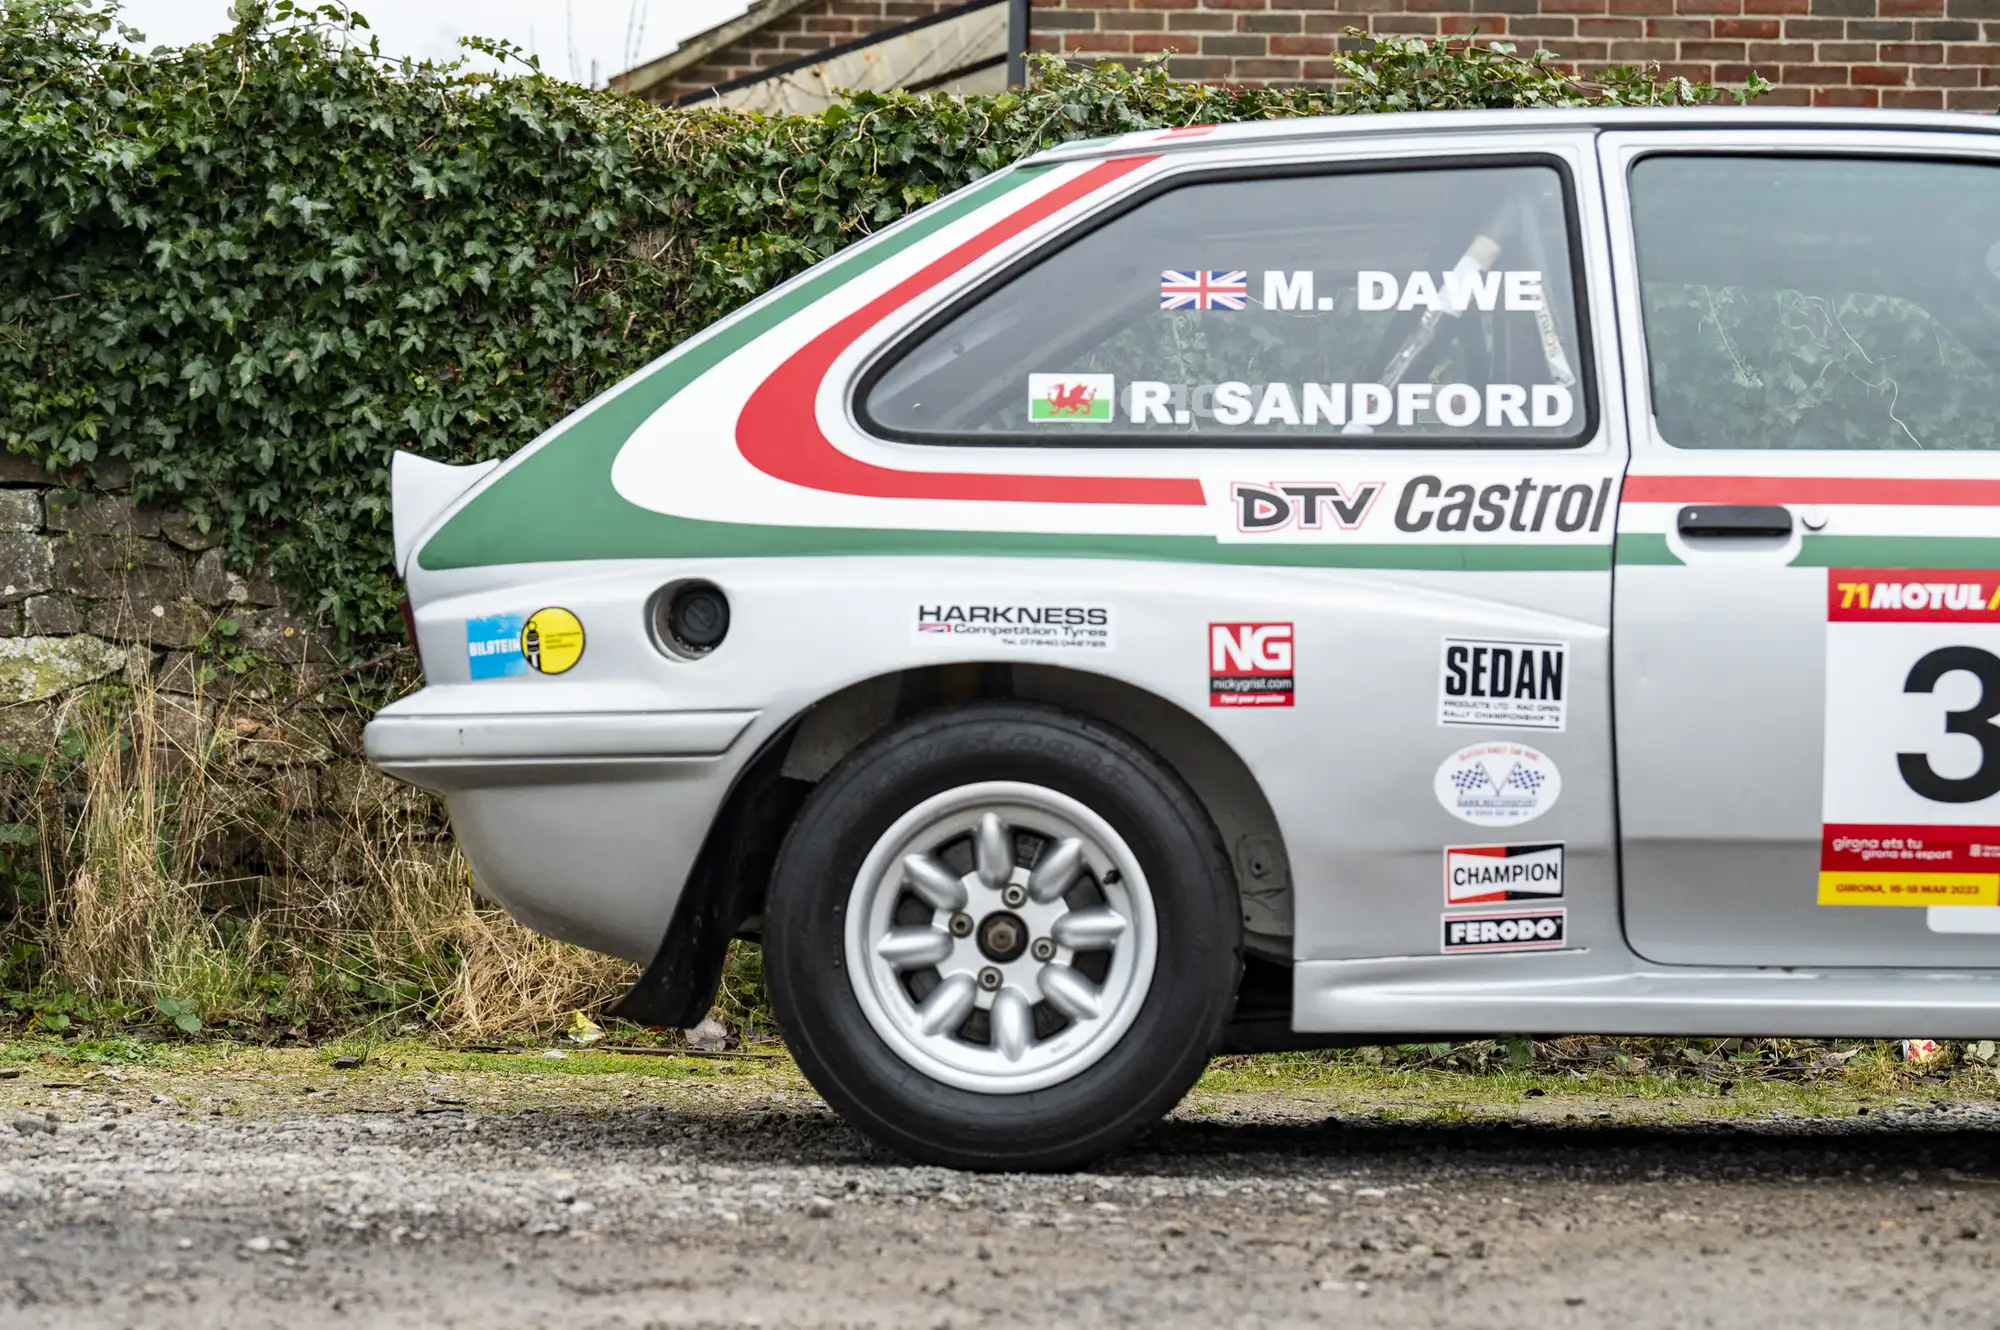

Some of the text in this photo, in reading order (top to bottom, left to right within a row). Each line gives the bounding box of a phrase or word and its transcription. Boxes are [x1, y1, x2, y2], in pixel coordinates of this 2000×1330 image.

[1263, 271, 1543, 312] M. DAWE
[1130, 380, 1574, 428] R. SANDFORD
[1237, 475, 1613, 533] DTV Castrol
[918, 605, 1108, 625] HARKNESS
[954, 623, 1108, 639] Competition Tyres
[469, 638, 521, 657] BILSTEIN
[1212, 625, 1292, 671] NG
[1446, 646, 1563, 700] SEDAN
[1212, 678, 1293, 691] nickygrist.com
[1832, 836, 1923, 853] girona ets tu
[1861, 849, 1899, 861] girona
[1915, 850, 1953, 861] esport
[1453, 862, 1558, 886] CHAMPION
[1836, 883, 1885, 895] GIRONA,
[1450, 918, 1557, 944] FERODO
